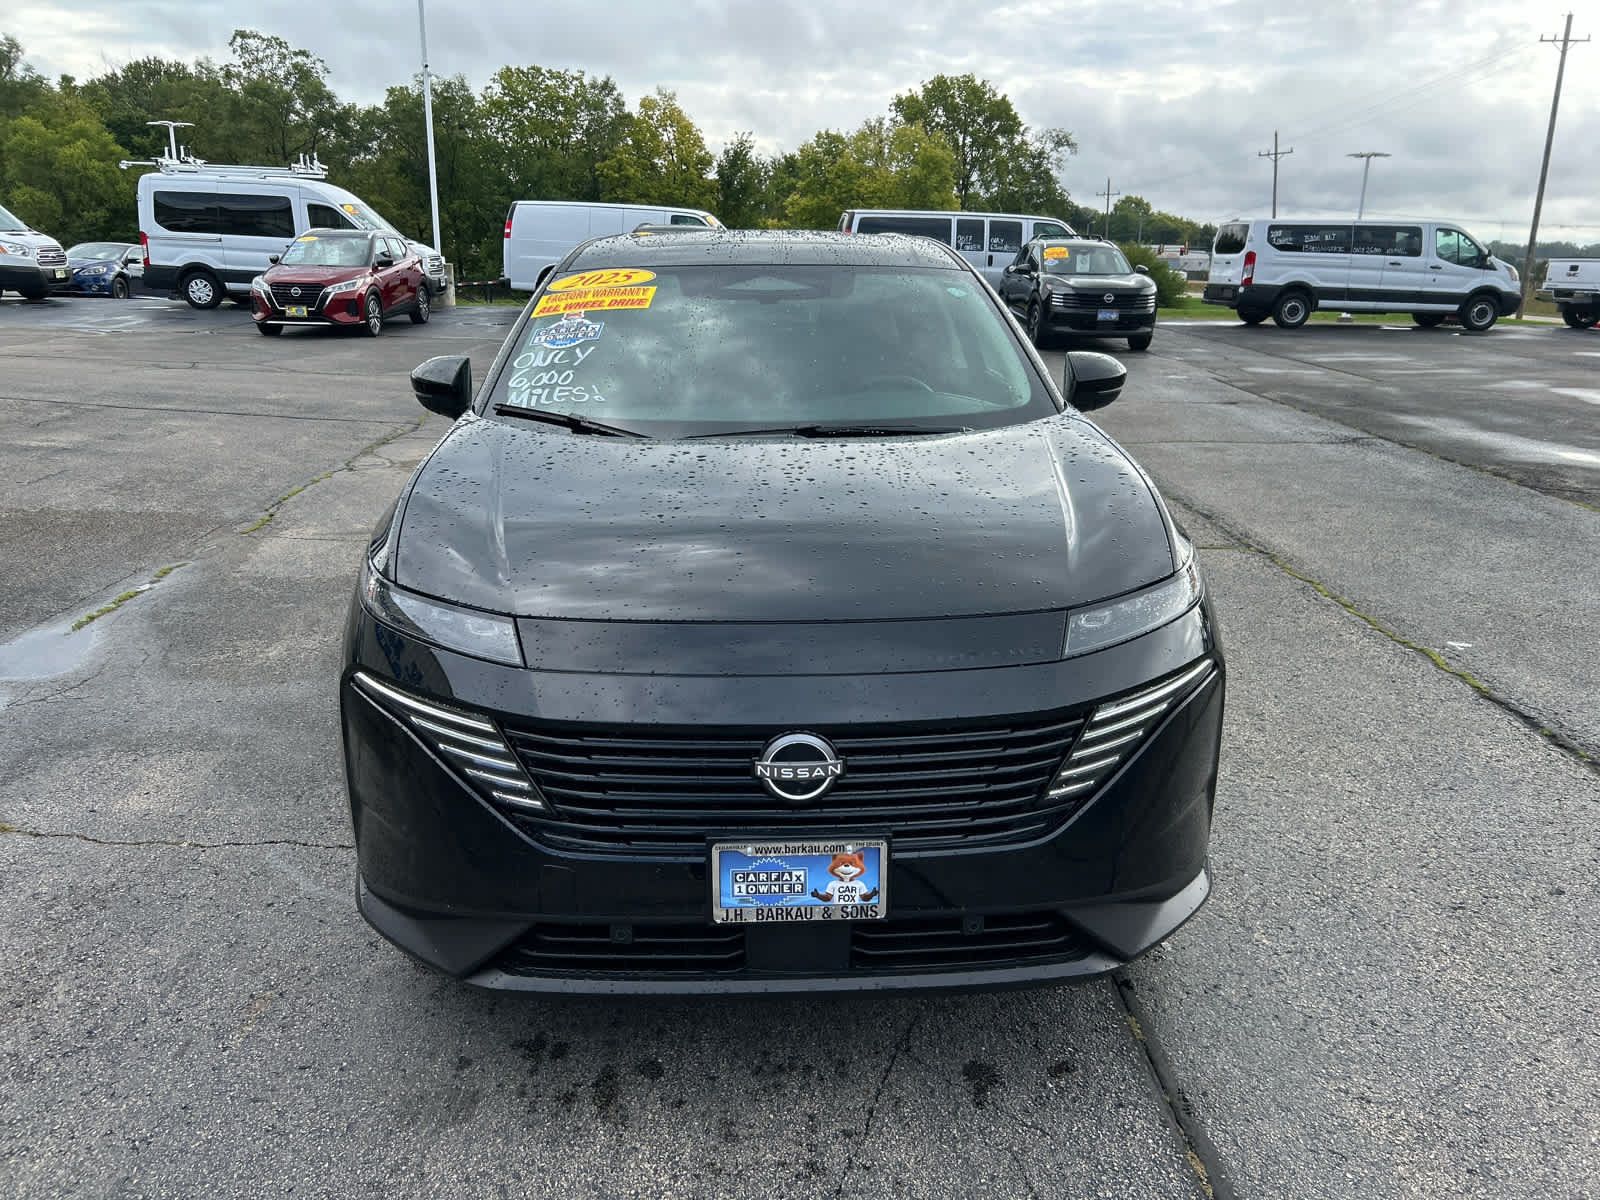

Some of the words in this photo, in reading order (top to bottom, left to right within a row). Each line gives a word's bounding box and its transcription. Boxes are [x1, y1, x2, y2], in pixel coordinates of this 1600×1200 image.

[562, 271, 640, 289] 2025
[546, 290, 592, 303] FACTORY
[592, 287, 650, 298] WARRANTY
[537, 303, 562, 314] ALL
[563, 299, 606, 311] WHEEL
[608, 298, 649, 308] DRIVE
[539, 325, 600, 336] CARFAX
[513, 346, 595, 369] ONLY
[508, 369, 575, 391] 6,000
[757, 763, 841, 778] NISSAN
[754, 844, 845, 855] www.barkau.com
[735, 871, 804, 882] CARFAX
[838, 886, 857, 895] CAR
[838, 894, 857, 903] FOX
[722, 908, 747, 922] J.H.
[756, 907, 813, 921] BARKAU
[821, 906, 832, 919] &
[841, 905, 878, 919] SONS
